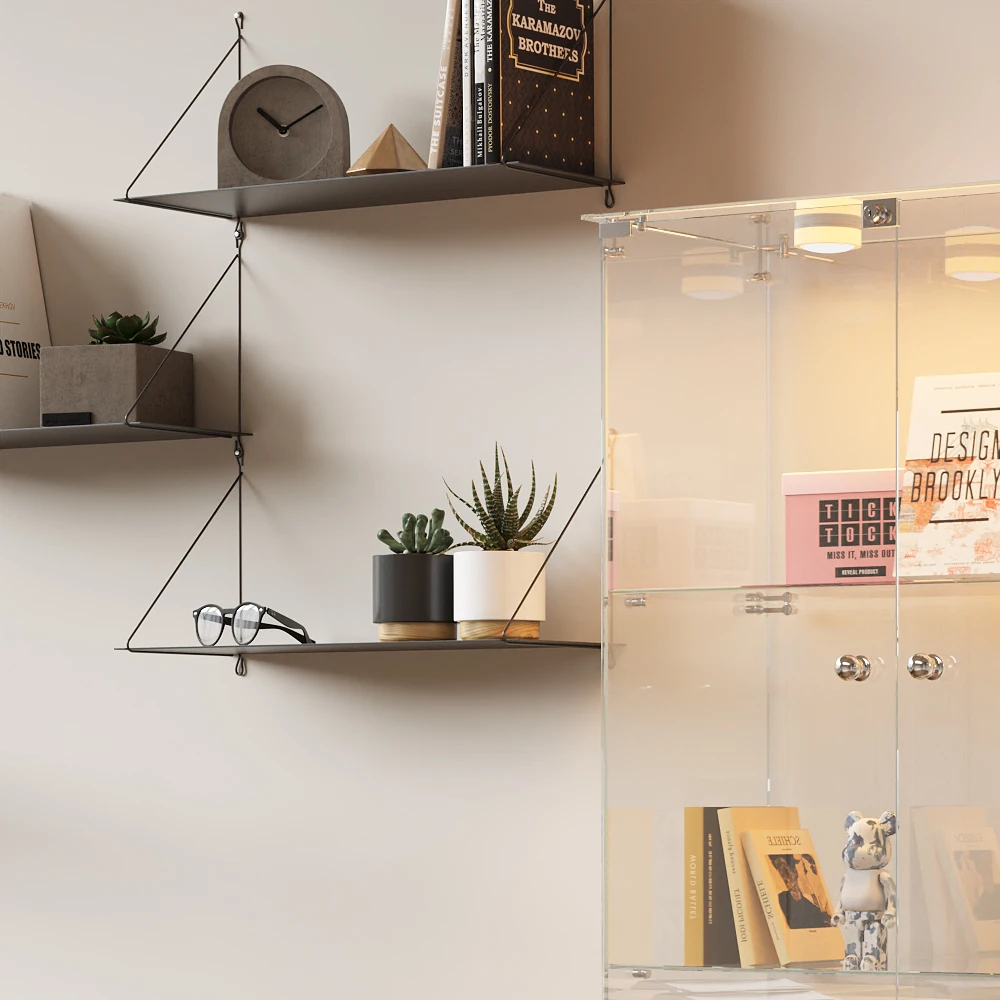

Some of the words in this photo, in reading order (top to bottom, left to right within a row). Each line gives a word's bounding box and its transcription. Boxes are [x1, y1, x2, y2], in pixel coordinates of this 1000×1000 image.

[512, 13, 582, 42] KARAMAZOV
[518, 36, 579, 63] BROTHERS
[433, 66, 447, 127] SUITCASE
[430, 131, 440, 153] THE
[5, 339, 40, 360] STORIES
[824, 501, 897, 519] TICK
[824, 525, 897, 543] TOCK
[827, 550, 845, 560] MISS
[848, 550, 857, 560] IT,
[860, 549, 879, 559] MISS
